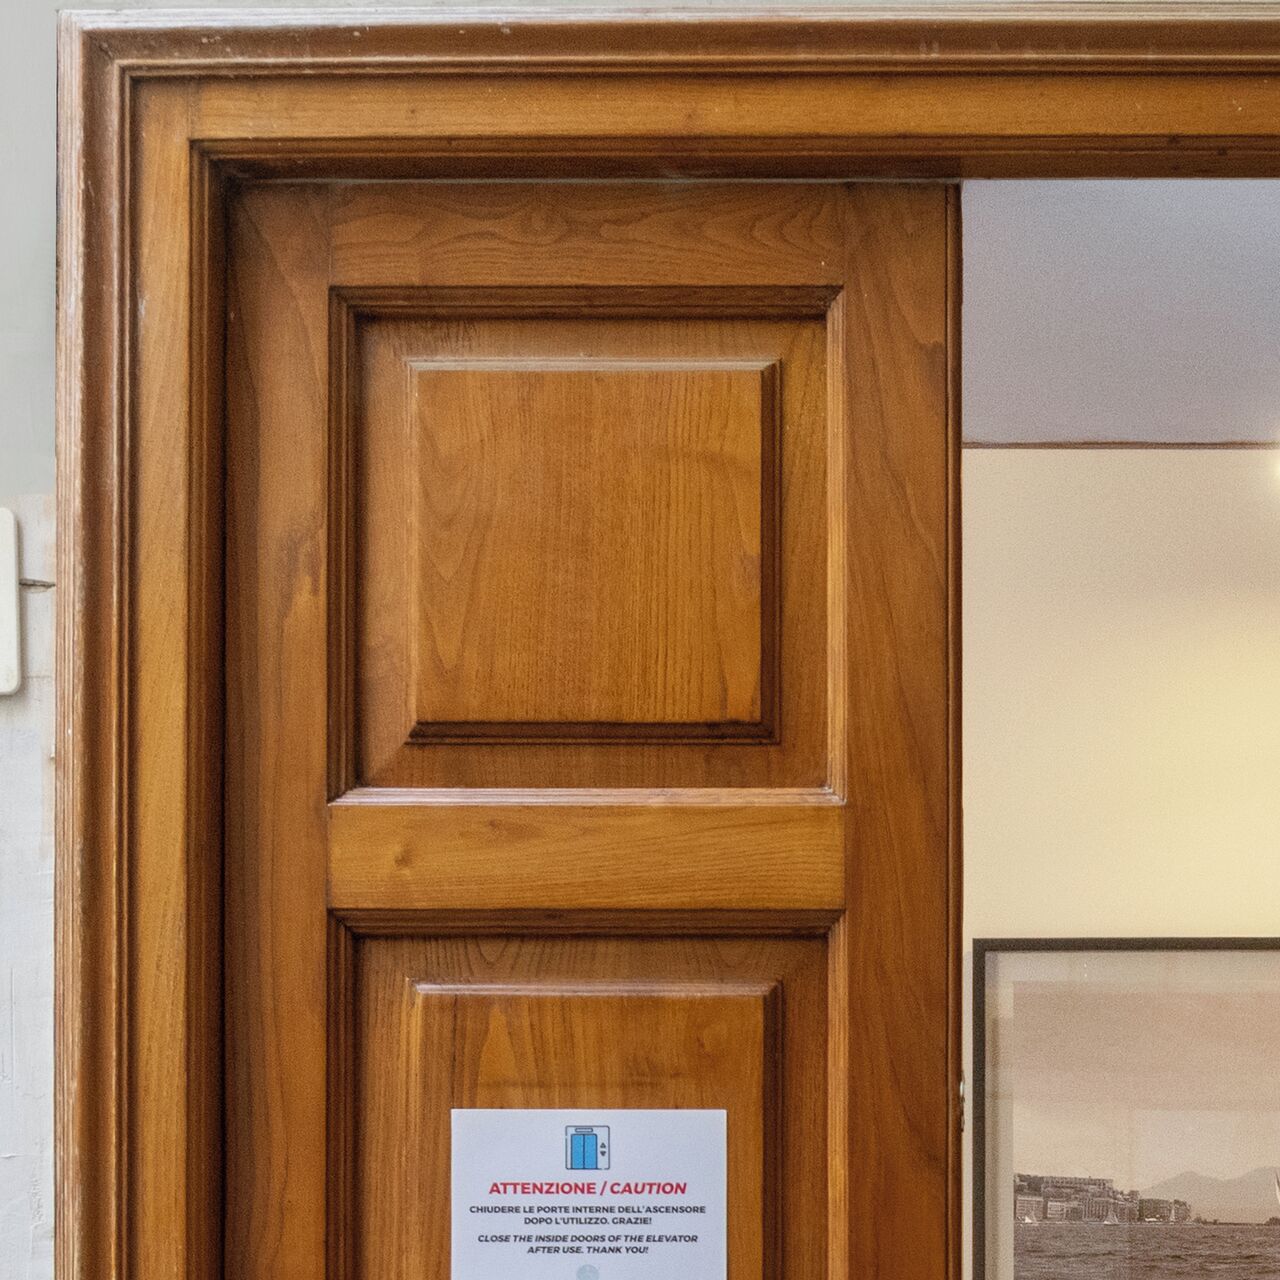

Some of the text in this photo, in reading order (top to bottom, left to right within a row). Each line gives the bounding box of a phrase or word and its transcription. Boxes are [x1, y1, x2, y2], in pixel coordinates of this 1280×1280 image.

[489, 1181, 597, 1195] ATTENZIONE
[610, 1181, 688, 1195] CAUTION
[469, 1205, 706, 1214] CHIUDERE LE PORTE INTERNE DELL'ASCENSORE
[524, 1216, 652, 1225] DOPO L'UTILIZZO. GRAZIE!
[478, 1234, 698, 1243] CLOSE THE INSIDE DOORS OF THE ELEVATOR
[527, 1246, 649, 1255] AFTER USE. THANK YOU!
